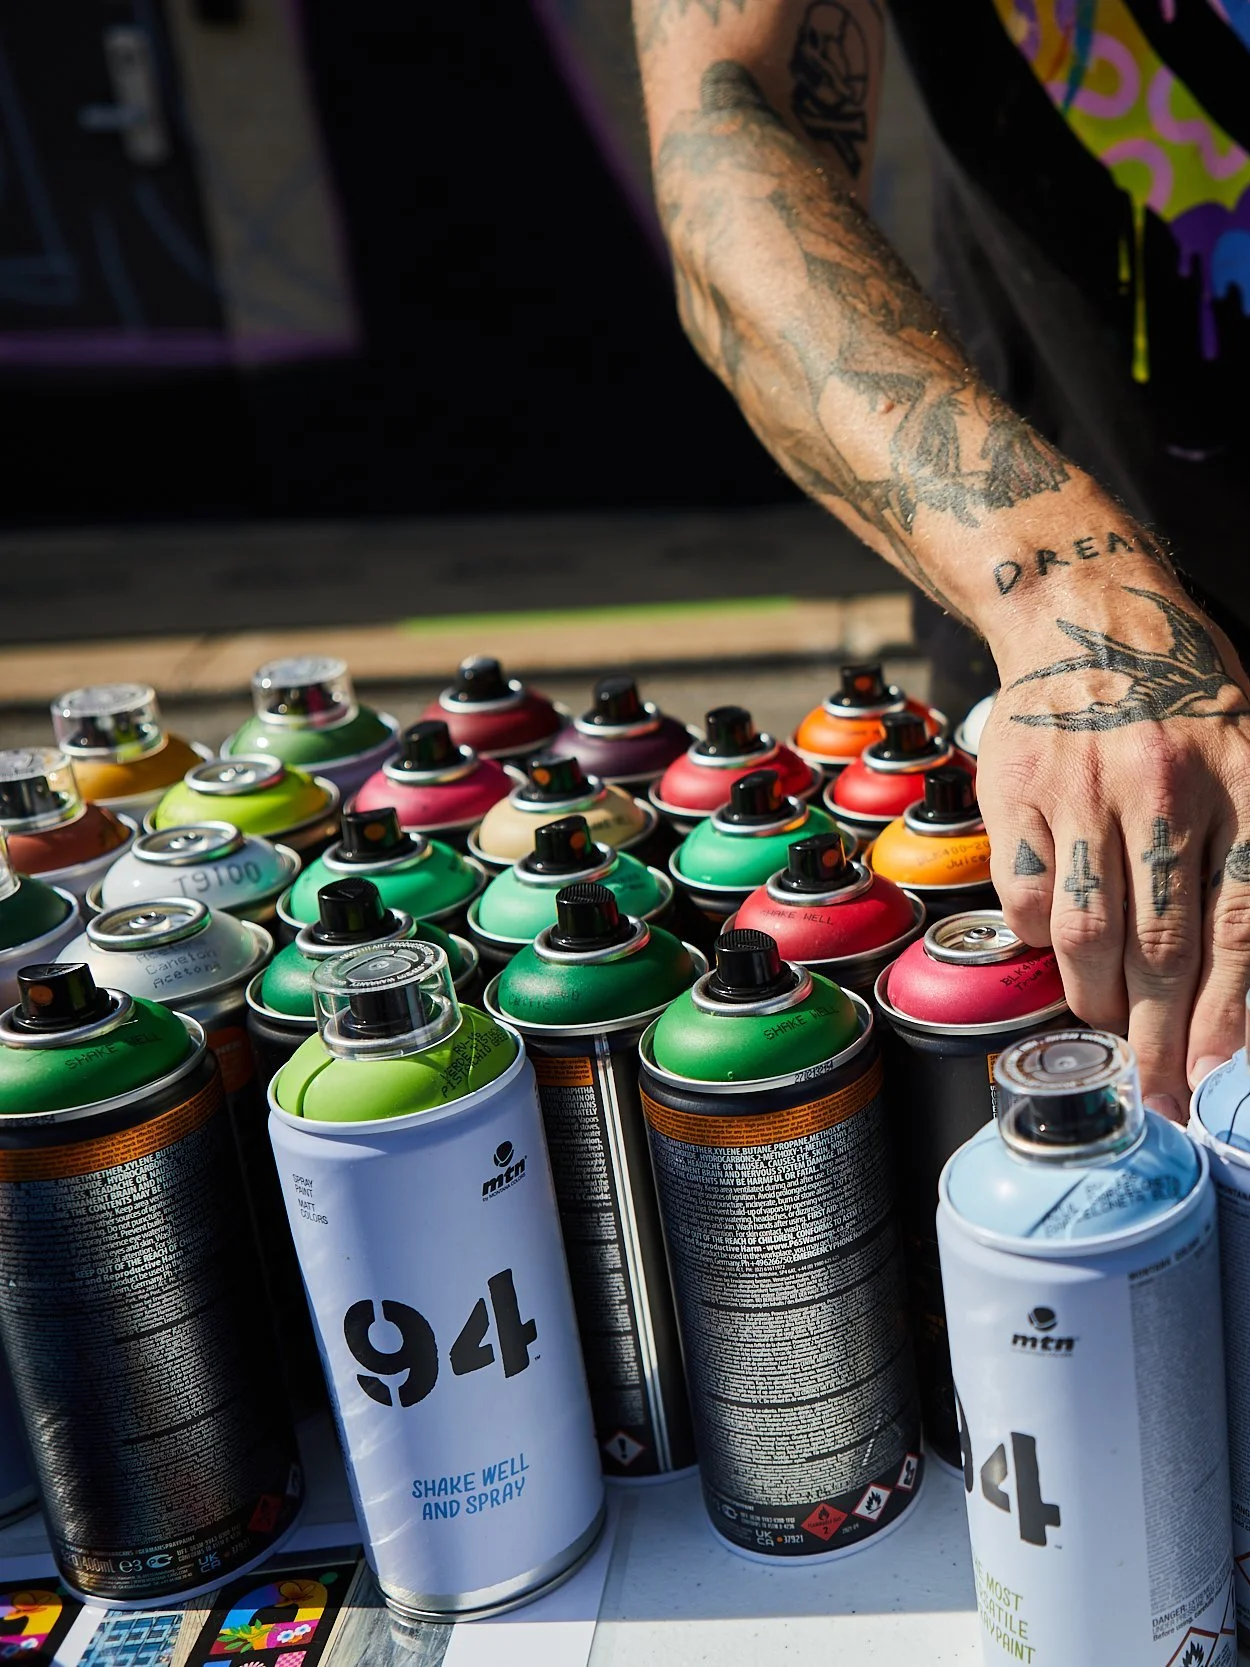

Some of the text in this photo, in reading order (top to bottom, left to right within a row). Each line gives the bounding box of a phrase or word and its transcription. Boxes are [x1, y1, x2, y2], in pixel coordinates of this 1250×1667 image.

[802, 913, 834, 926] WELL
[763, 1003, 841, 1040] SHAKE WELL
[65, 1043, 115, 1070] SHAKE
[688, 1160, 721, 1170] HEADACHE
[768, 1156, 795, 1168] CAUSES
[702, 1169, 724, 1177] BRAIN
[742, 1167, 776, 1178] NERVOUS
[777, 1161, 806, 1174] SYSTEM
[292, 1173, 313, 1188] SPRAY
[720, 1178, 735, 1186] MAY
[736, 1178, 746, 1186] BE
[747, 1174, 785, 1185] HARMFUL
[785, 1172, 795, 1180] OR
[734, 1175, 814, 1194] ventilated and after
[90, 1179, 135, 1198] HEADACHE
[110, 1180, 155, 1199] BRAIN AND
[295, 1183, 313, 1198] PAINT
[758, 1184, 807, 1199] Avoid prolonged
[88, 1185, 162, 1214] CONTENTS MAY BE
[297, 1199, 316, 1212] MATT
[300, 1208, 328, 1225] COLORS
[807, 1210, 825, 1220] FIRST
[725, 1223, 833, 1245] REACH OF CHILDREN. CONFORMS
[793, 1234, 854, 1262] EMERGENCY PHONE
[143, 1249, 168, 1265] REACH
[162, 1249, 184, 1265] Harm
[344, 1268, 537, 1408] 94
[412, 1453, 529, 1498] SHAKE WELL
[422, 1476, 526, 1520] AND SPRAY
[756, 1529, 772, 1538] UK
[822, 1526, 829, 1535] 2
[986, 1572, 1023, 1611] MOST
[1152, 1603, 1187, 1627] DANGER:
